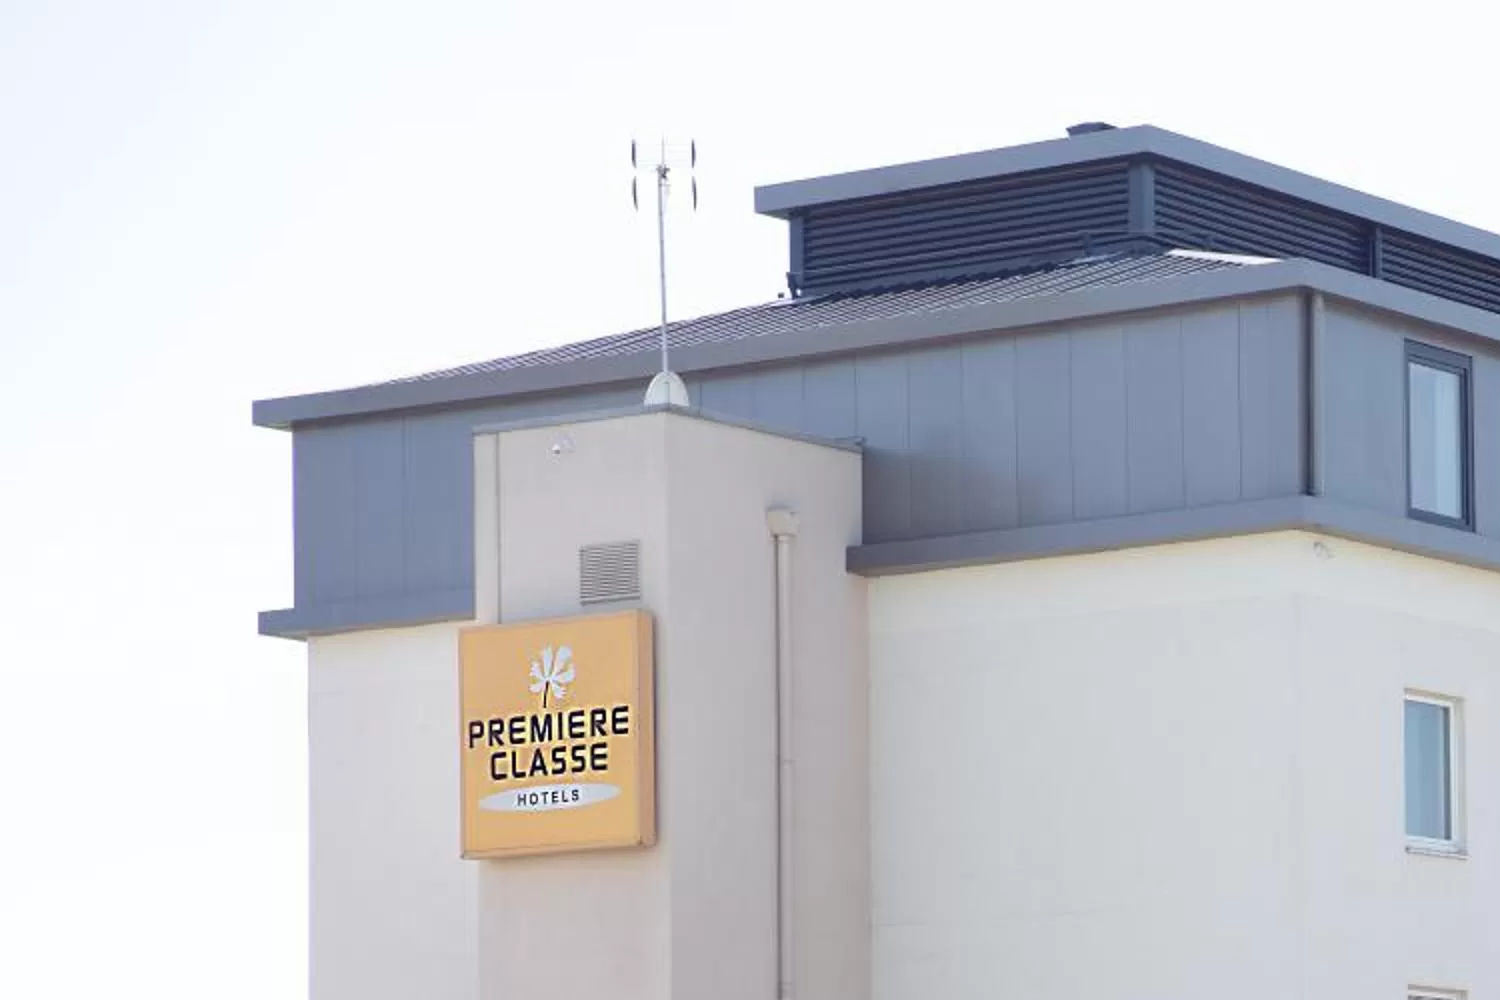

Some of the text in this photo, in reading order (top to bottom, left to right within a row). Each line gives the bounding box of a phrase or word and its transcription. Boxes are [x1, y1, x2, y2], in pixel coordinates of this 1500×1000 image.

[469, 706, 629, 748] PREMIERE
[491, 742, 608, 781] CLASSE
[517, 789, 580, 806] HOTELS
